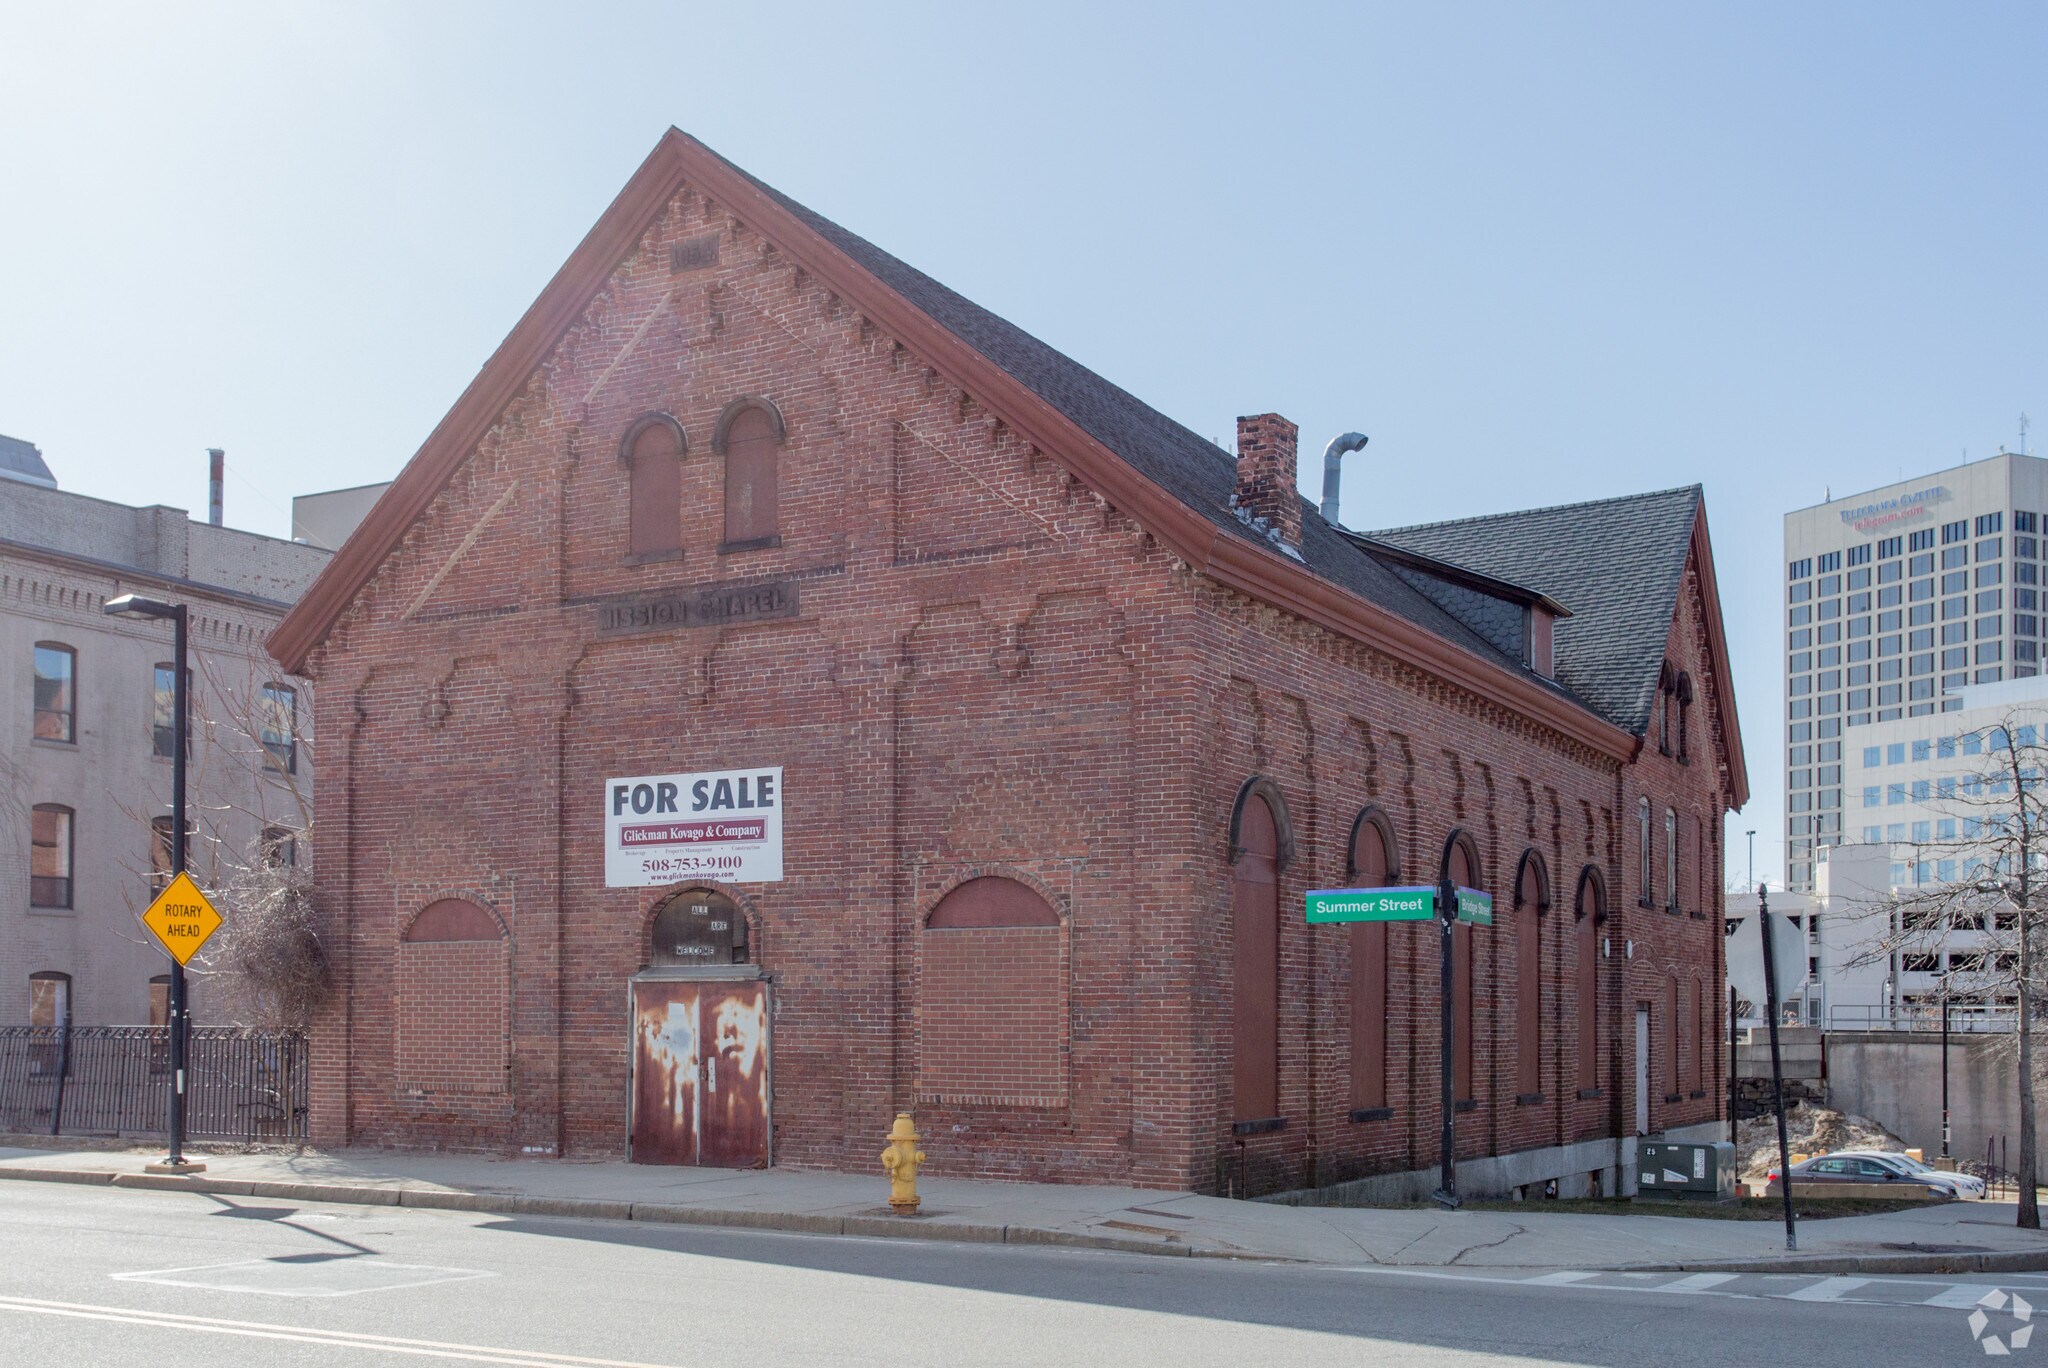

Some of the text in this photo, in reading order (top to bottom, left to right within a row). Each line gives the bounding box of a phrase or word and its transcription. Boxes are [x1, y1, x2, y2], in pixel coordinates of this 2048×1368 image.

[1854, 505, 1924, 530] telegram.com
[600, 601, 687, 630] MISSION
[613, 775, 774, 816] FOR SALE
[624, 824, 762, 843] Glickman Kovago & Company
[642, 855, 742, 872] 508-753-9100
[651, 871, 735, 881] www.glickmankovago.com
[165, 904, 202, 918] ROTARY
[1316, 898, 1423, 913] Summer Street
[1461, 898, 1490, 916] Bridge Street
[167, 924, 200, 937] AHEAD
[677, 946, 714, 955] WELCOME
[1646, 1147, 1656, 1156] 25
